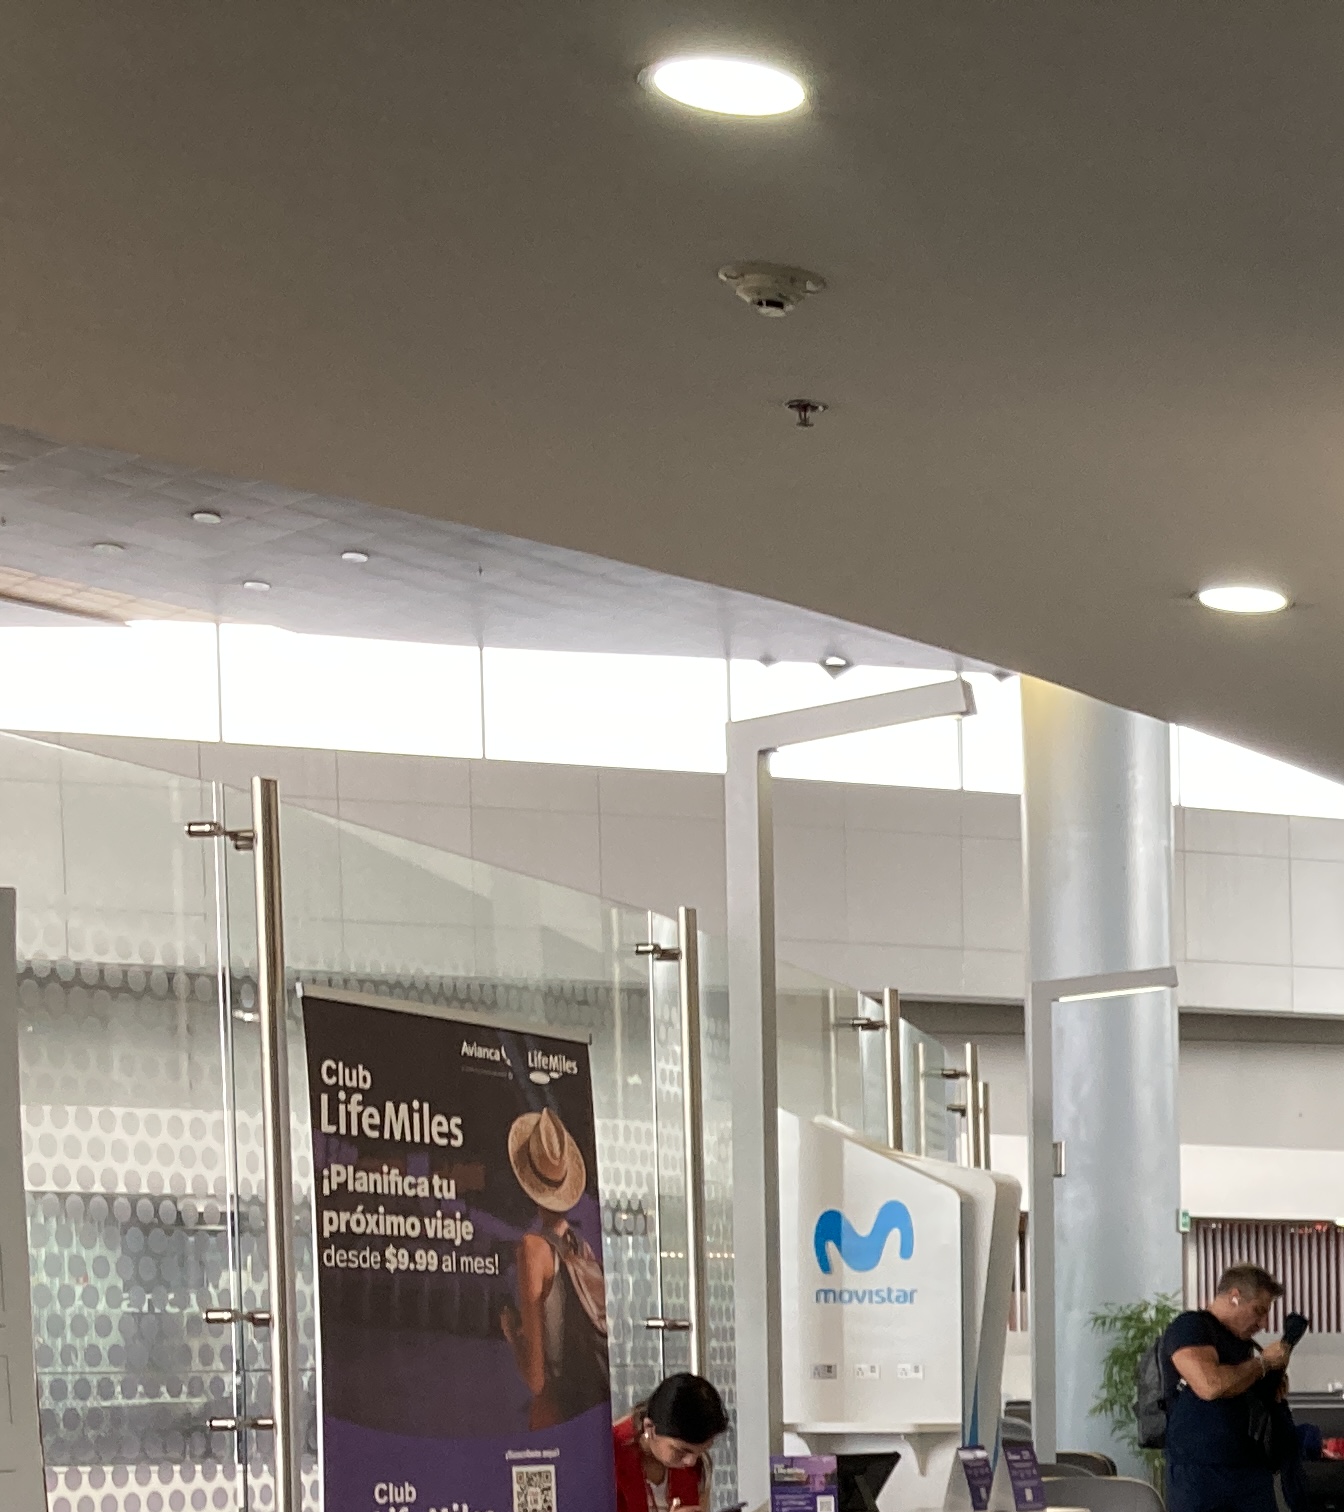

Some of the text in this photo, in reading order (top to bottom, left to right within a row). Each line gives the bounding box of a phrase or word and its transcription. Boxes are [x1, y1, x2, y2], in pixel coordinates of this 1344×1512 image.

[321, 1059, 371, 1090] Club
[321, 1090, 463, 1147] LifeMiles
[322, 1163, 456, 1200] ¡Planifica tu
[322, 1205, 474, 1246] próximo viaje
[323, 1244, 499, 1275] desde $9.99 al mes!
[815, 1286, 918, 1305] movistar
[374, 1481, 417, 1504] Club
